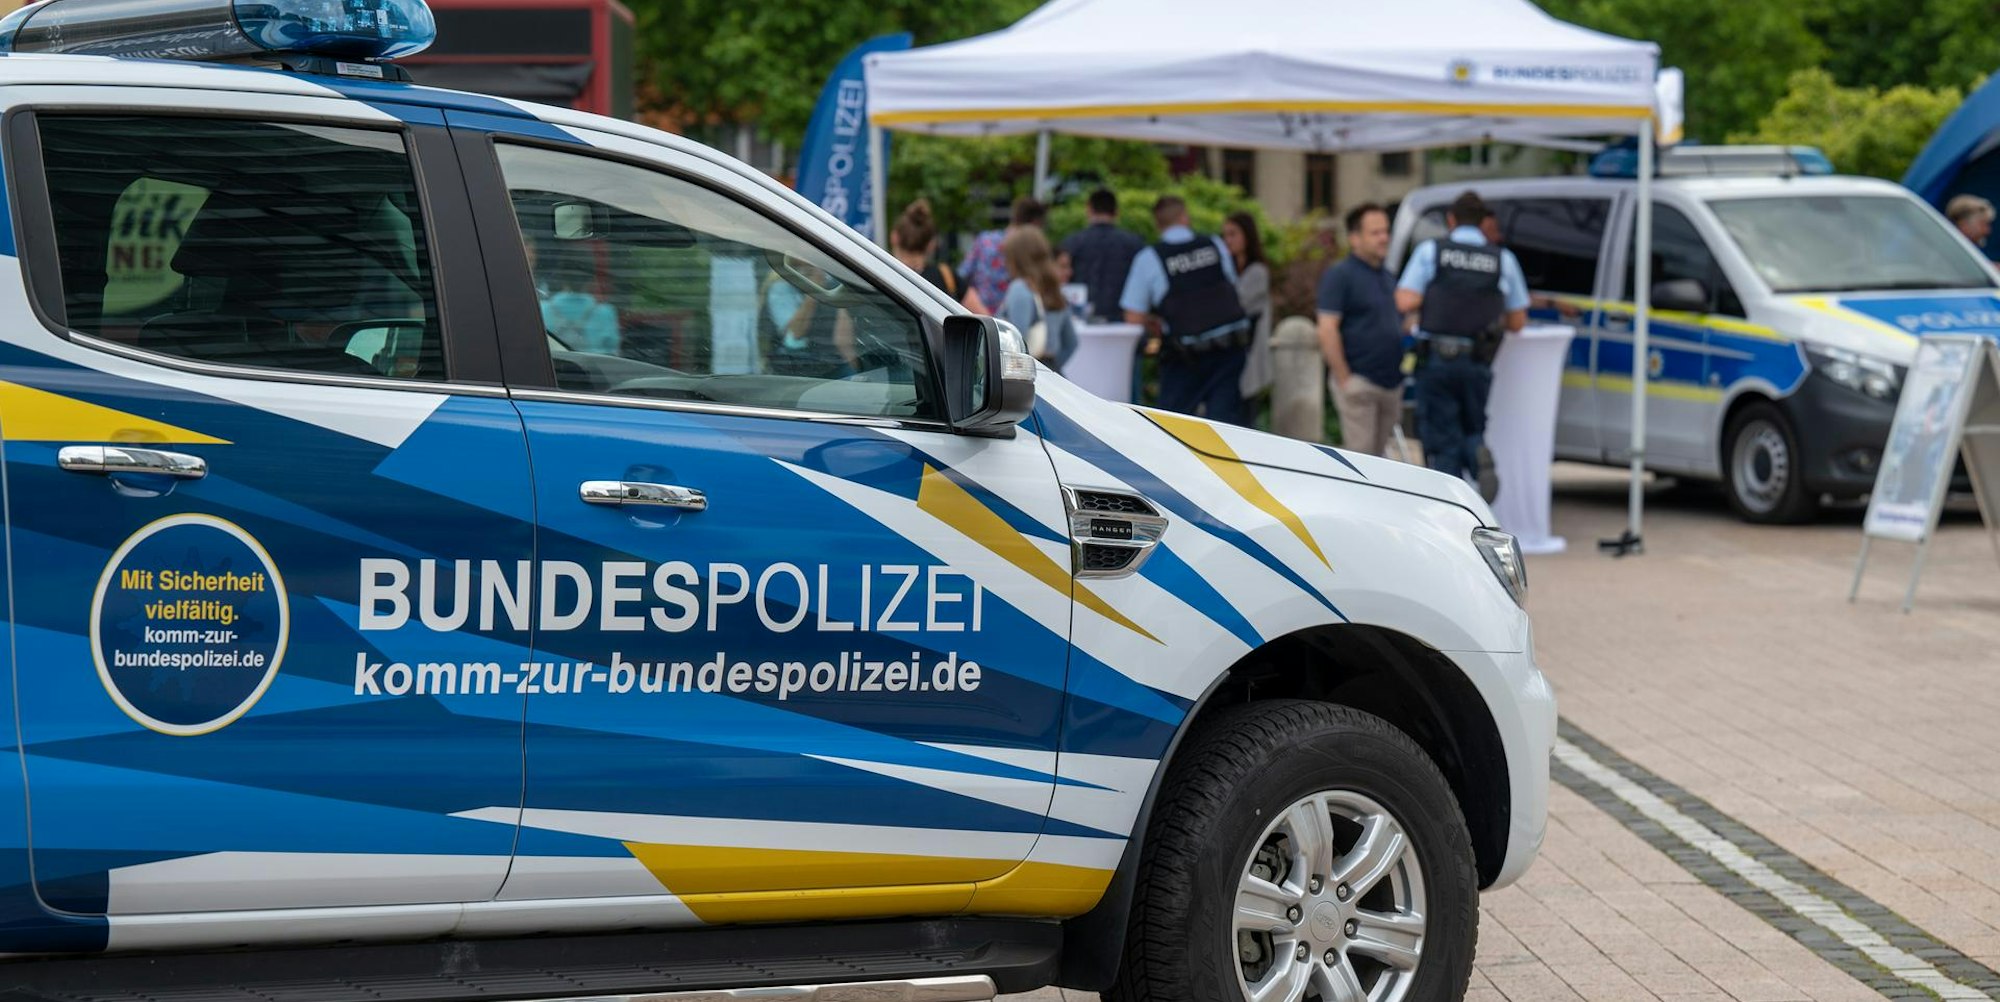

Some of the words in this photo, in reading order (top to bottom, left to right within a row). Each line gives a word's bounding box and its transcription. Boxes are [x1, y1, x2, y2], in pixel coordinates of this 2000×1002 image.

[1166, 246, 1219, 276] POLIZEI
[1440, 248, 1499, 273] POLIZEI
[1091, 525, 1132, 533] RANGER
[121, 569, 153, 590] Mit
[159, 570, 265, 592] Sicherheit
[358, 557, 983, 634] BUNDESPOLIZEI
[144, 600, 239, 625] vielfältig.
[144, 626, 238, 643] komm-zur-
[114, 650, 264, 671] bundespolizei.de
[354, 651, 982, 701] komm-zur-bundespolizei.de
